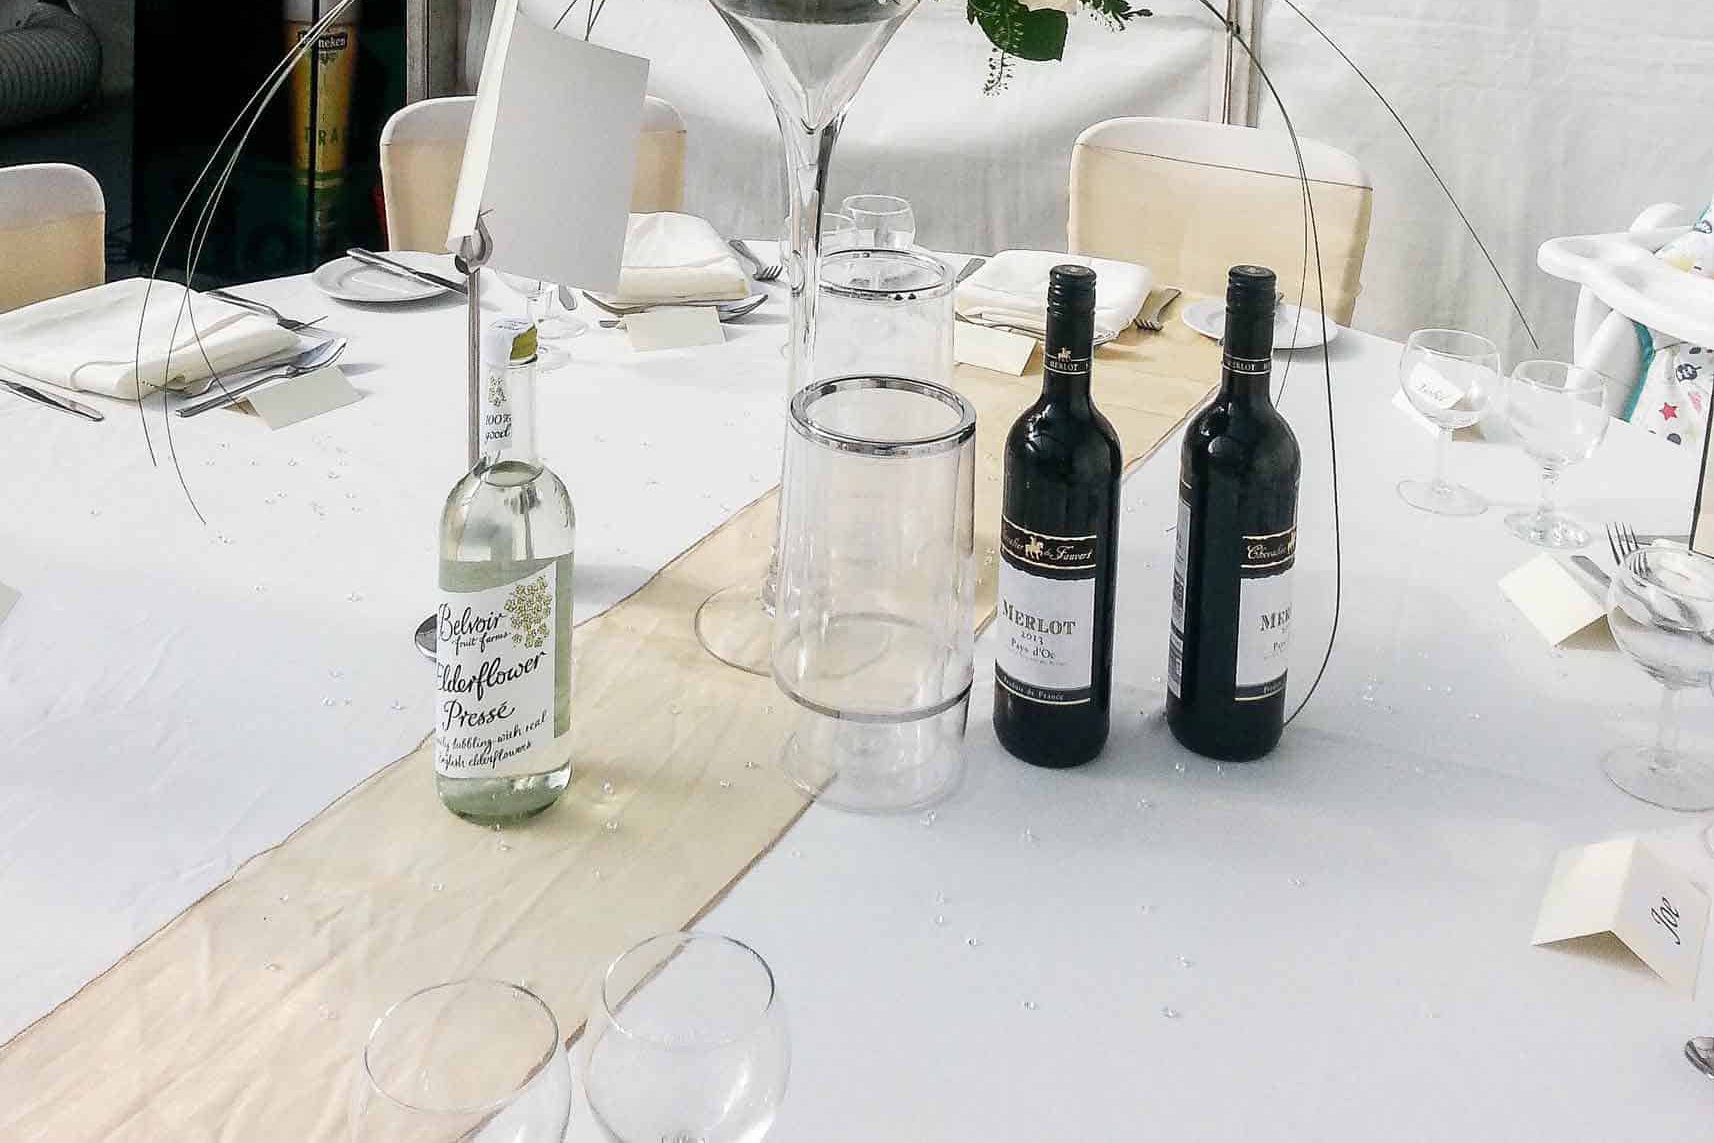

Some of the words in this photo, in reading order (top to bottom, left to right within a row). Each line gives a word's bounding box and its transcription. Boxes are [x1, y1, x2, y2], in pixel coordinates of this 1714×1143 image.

[438, 603, 506, 642] Belvoir
[1002, 596, 1076, 635] MERLOT
[454, 636, 478, 656] fruit
[479, 631, 510, 653] farms
[442, 700, 516, 731] Pressé
[496, 726, 522, 744] with
